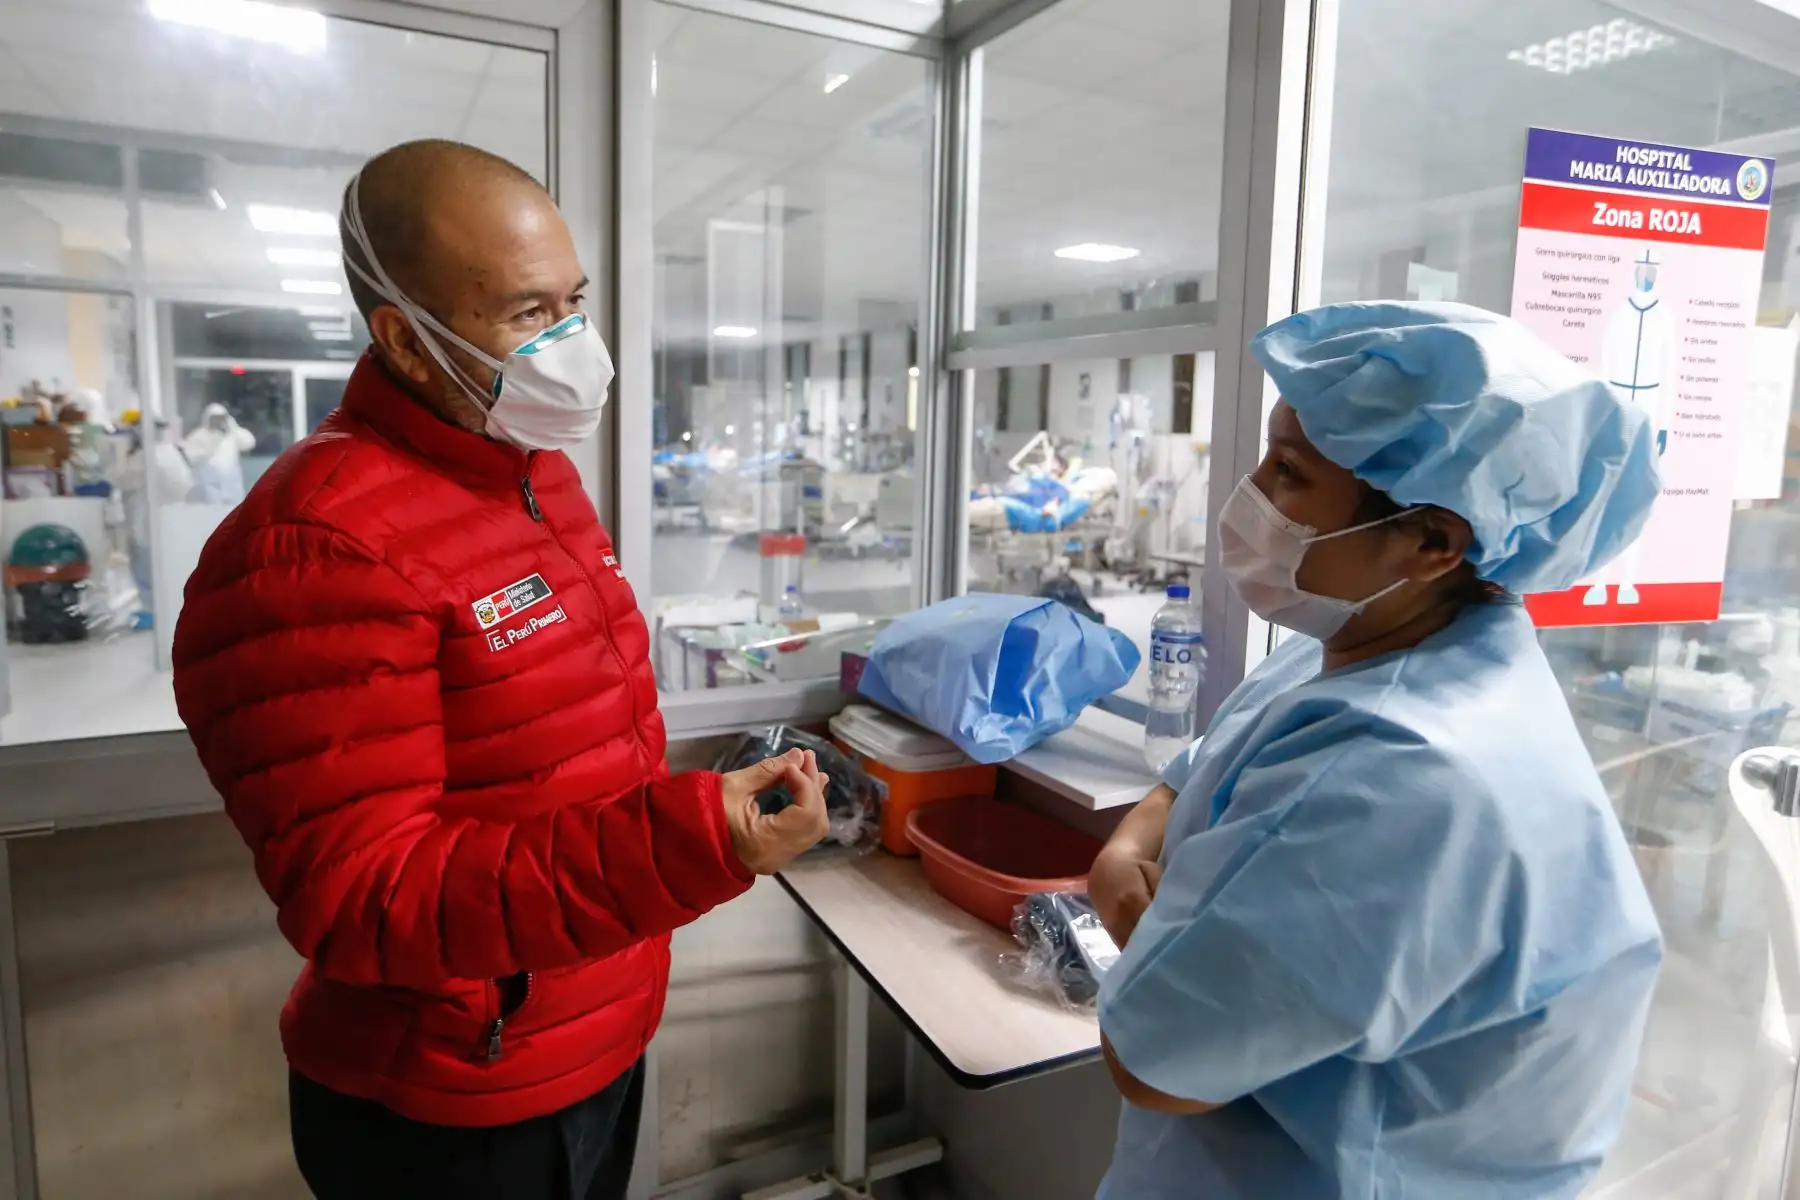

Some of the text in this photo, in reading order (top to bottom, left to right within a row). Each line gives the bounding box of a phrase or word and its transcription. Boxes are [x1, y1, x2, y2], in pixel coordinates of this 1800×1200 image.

[1616, 145, 1693, 171] HOSPITAL
[1570, 160, 1732, 195] MARIA AUXILIADORA
[1592, 202, 1702, 235] Zona ROJA
[1535, 247, 1556, 257] Gorro
[1593, 253, 1606, 262] con
[1607, 253, 1620, 264] liga
[1541, 270, 1570, 282] Goggles
[1587, 291, 1602, 301] N95
[1525, 301, 1566, 312] Cubrebocas
[1562, 318, 1586, 329] Careta
[507, 582, 533, 599] Ministerio
[513, 591, 536, 608] de Salud
